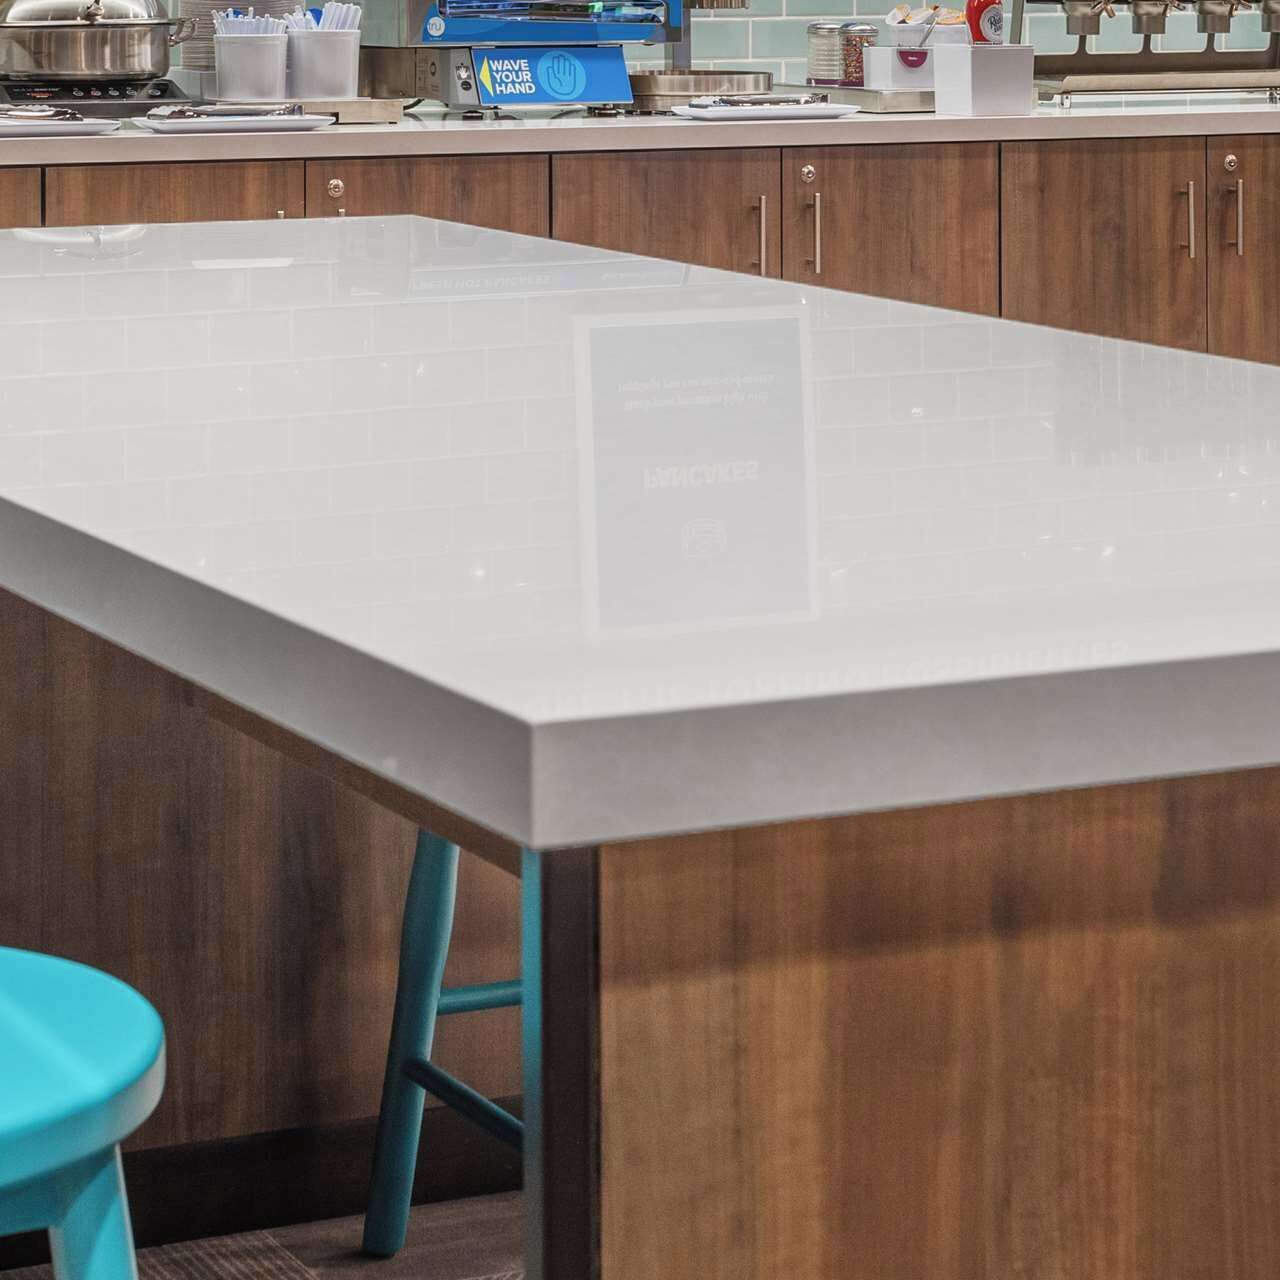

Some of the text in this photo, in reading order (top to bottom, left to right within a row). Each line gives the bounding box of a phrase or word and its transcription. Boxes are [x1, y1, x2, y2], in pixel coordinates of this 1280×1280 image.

[489, 59, 529, 71] WAVE
[493, 71, 532, 83] YOUR
[495, 82, 536, 95] HAND
